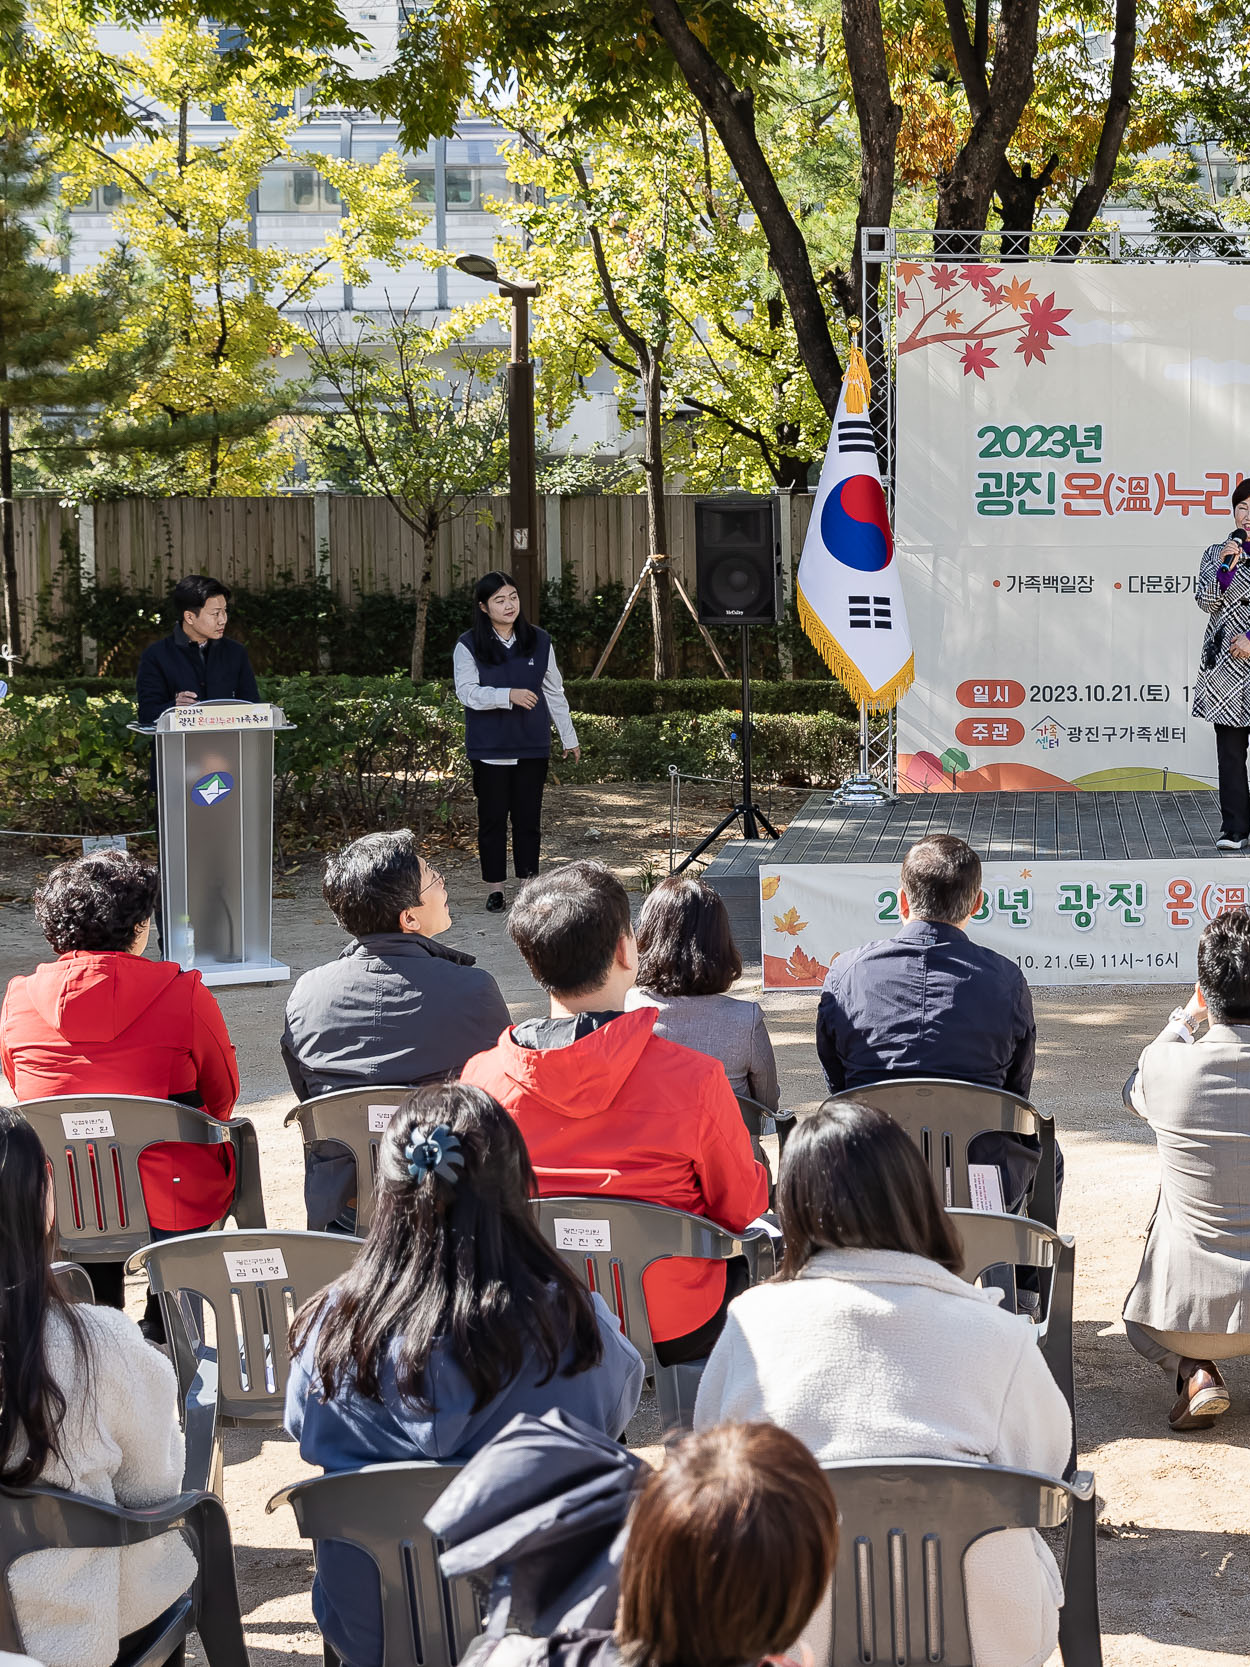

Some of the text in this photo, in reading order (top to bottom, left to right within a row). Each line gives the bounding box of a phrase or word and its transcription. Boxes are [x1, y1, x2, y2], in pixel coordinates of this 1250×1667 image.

[977, 424, 1103, 463] 2023년
[974, 471, 1056, 516] 광진
[1006, 575, 1095, 594] 가족백일장
[972, 684, 1010, 704] 일시
[1029, 684, 1170, 703] 2023.10.21.(토)
[971, 722, 1187, 744] 주관 광진구가족센터
[877, 888, 1029, 925] 23년
[1058, 883, 1143, 928] 광진
[1101, 951, 1179, 969] 11시~16시
